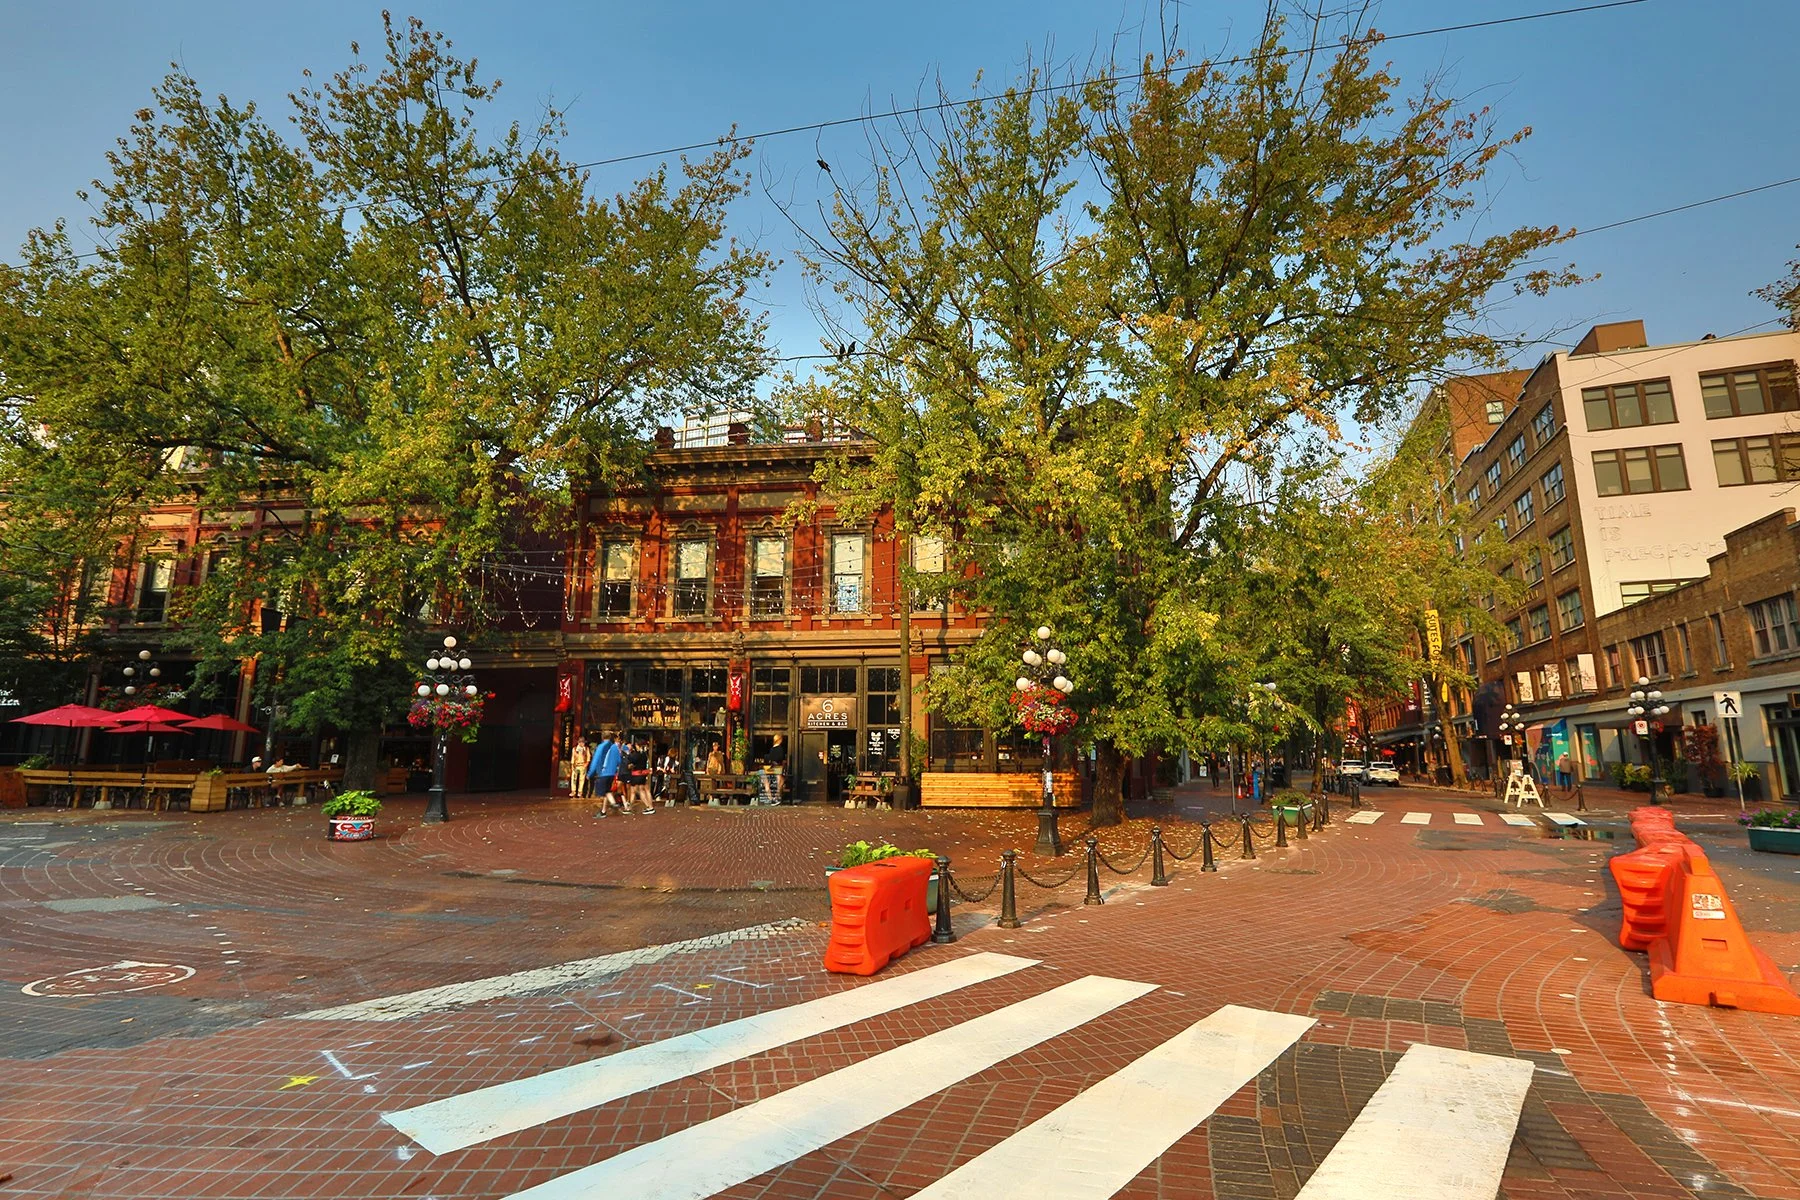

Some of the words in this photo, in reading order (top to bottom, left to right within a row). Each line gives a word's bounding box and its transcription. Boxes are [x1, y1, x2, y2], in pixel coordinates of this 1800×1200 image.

[1594, 503, 1652, 520] TIME
[1600, 526, 1620, 541] IS
[1428, 614, 1439, 643] SUITES
[822, 699, 834, 713] 6
[808, 712, 848, 720] ACRES
